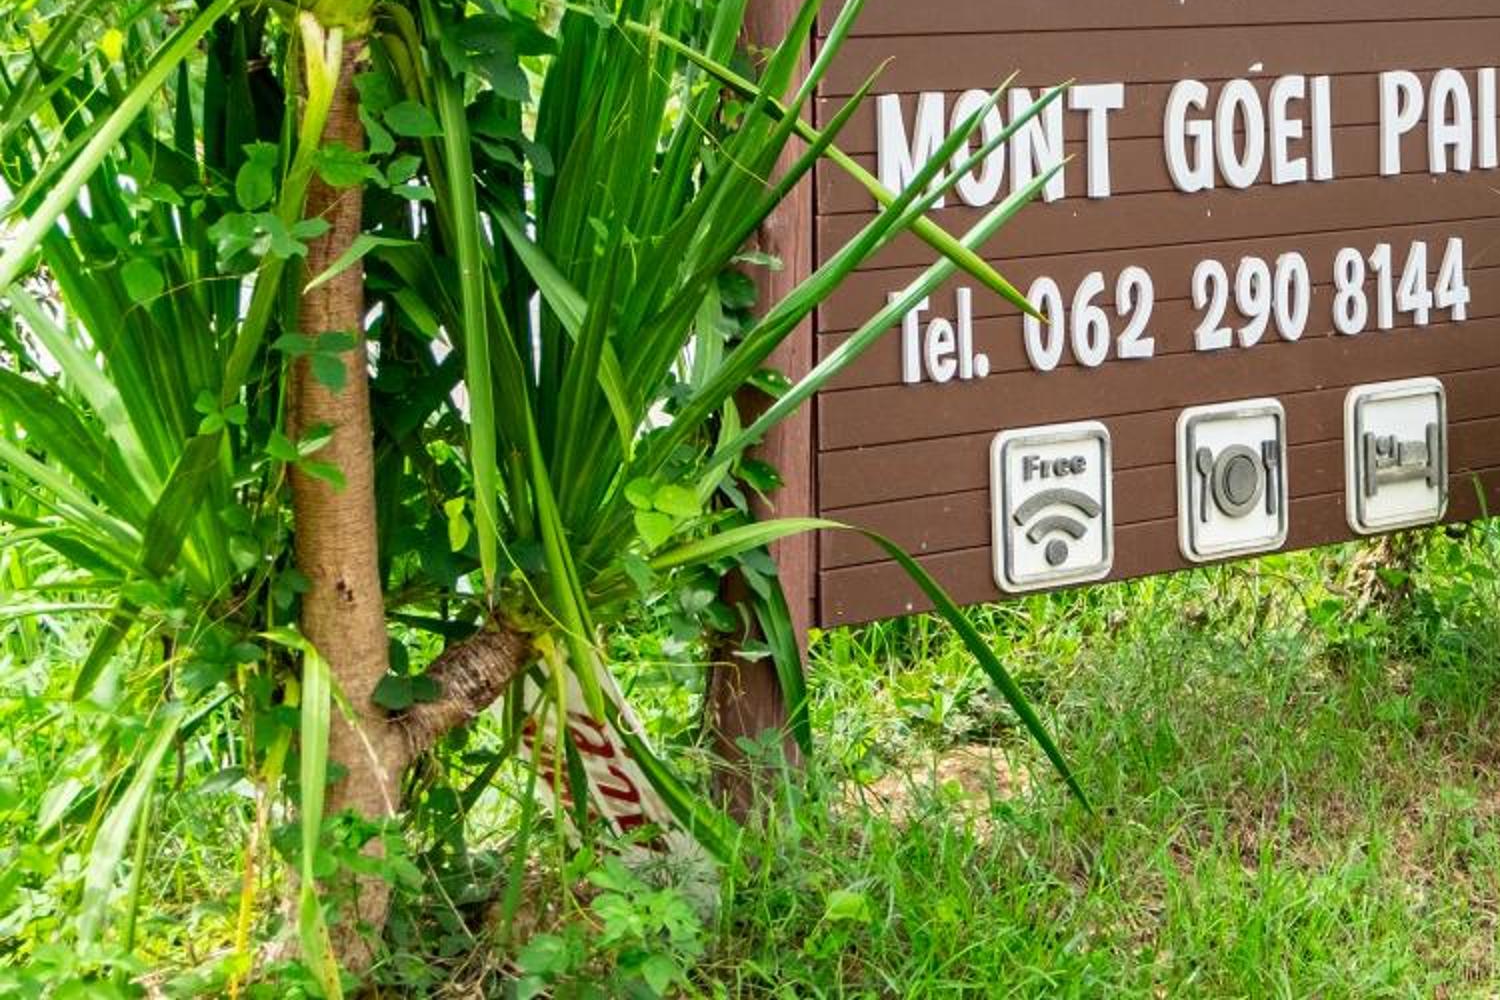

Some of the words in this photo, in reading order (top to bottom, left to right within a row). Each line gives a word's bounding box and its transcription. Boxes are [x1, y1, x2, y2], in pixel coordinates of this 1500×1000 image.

[876, 83, 1125, 212] MONT
[1163, 75, 1334, 193] GOEI
[1379, 67, 1498, 175] PAI
[888, 286, 990, 384] Tel.
[1023, 265, 1154, 373] 062
[1193, 251, 1311, 351] 290
[1333, 237, 1470, 335] 8144
[1021, 453, 1087, 483] Free
